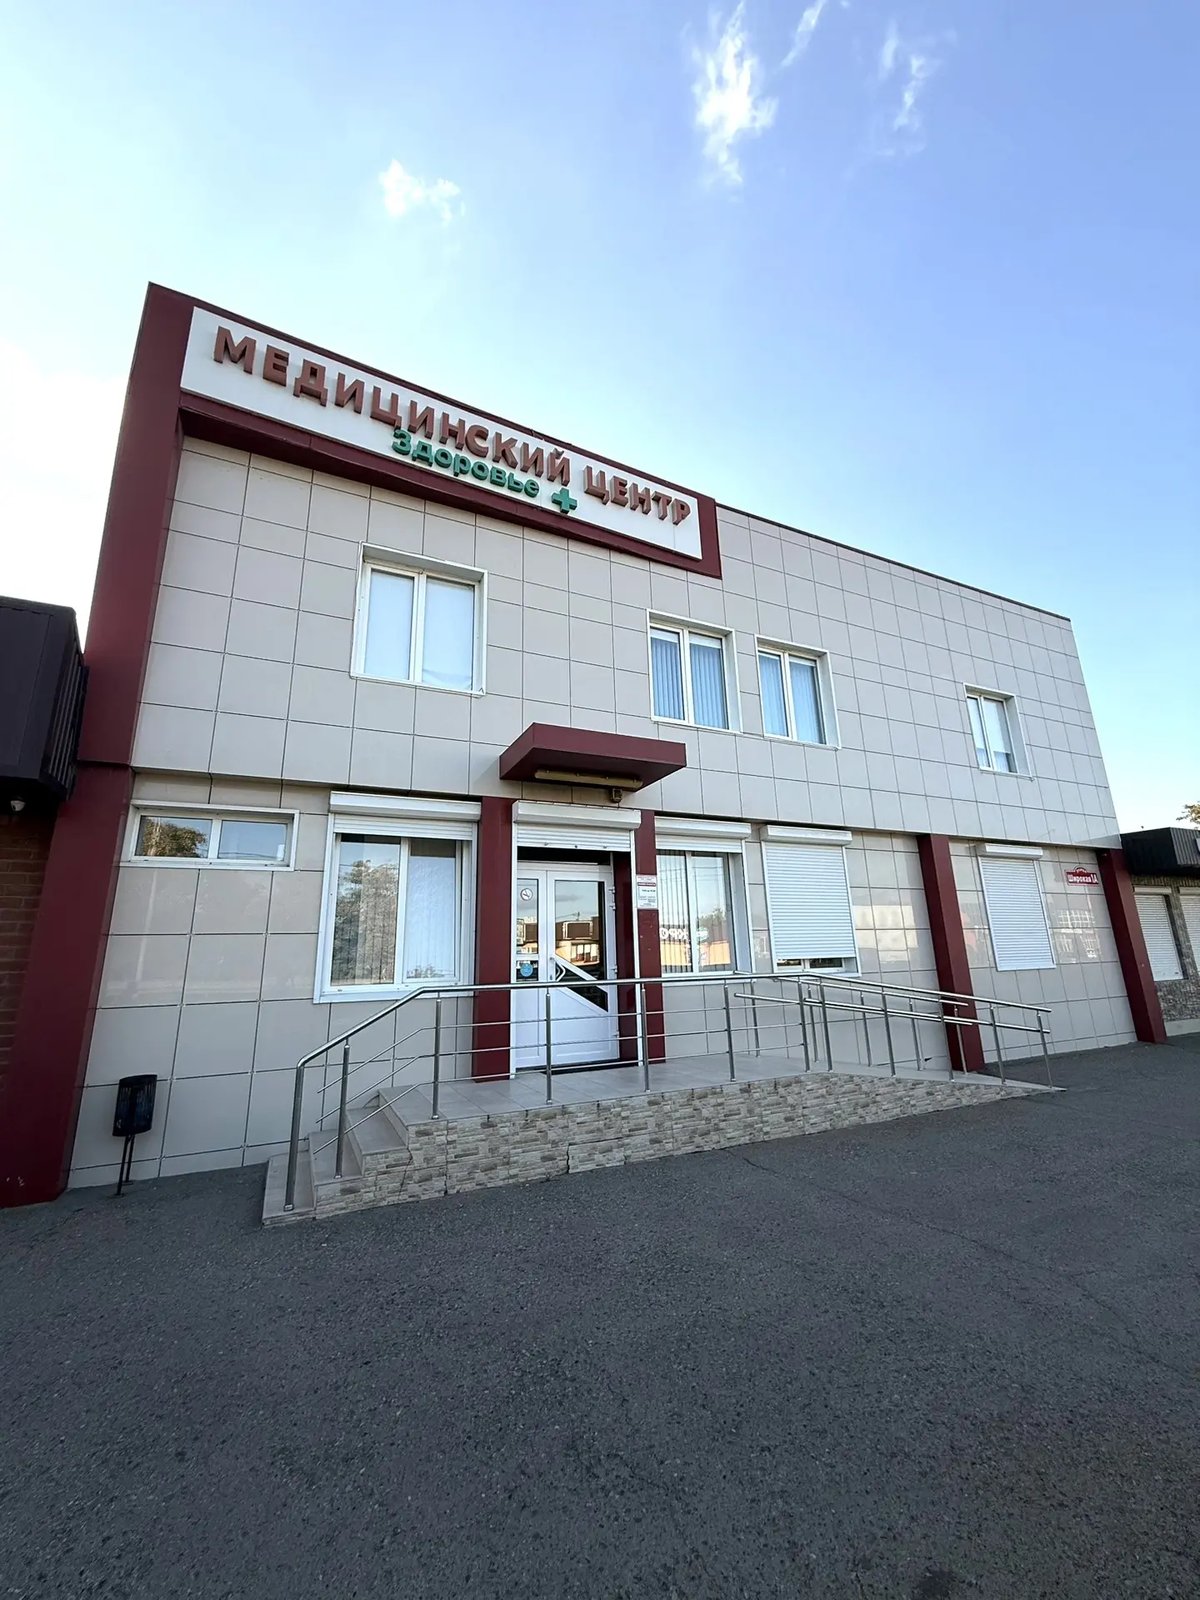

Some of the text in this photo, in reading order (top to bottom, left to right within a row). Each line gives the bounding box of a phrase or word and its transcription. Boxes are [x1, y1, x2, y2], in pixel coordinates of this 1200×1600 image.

[213, 325, 691, 526] МЕДИЦИНСКИЙ ЦЕНТР
[391, 428, 540, 498] Здоровье
